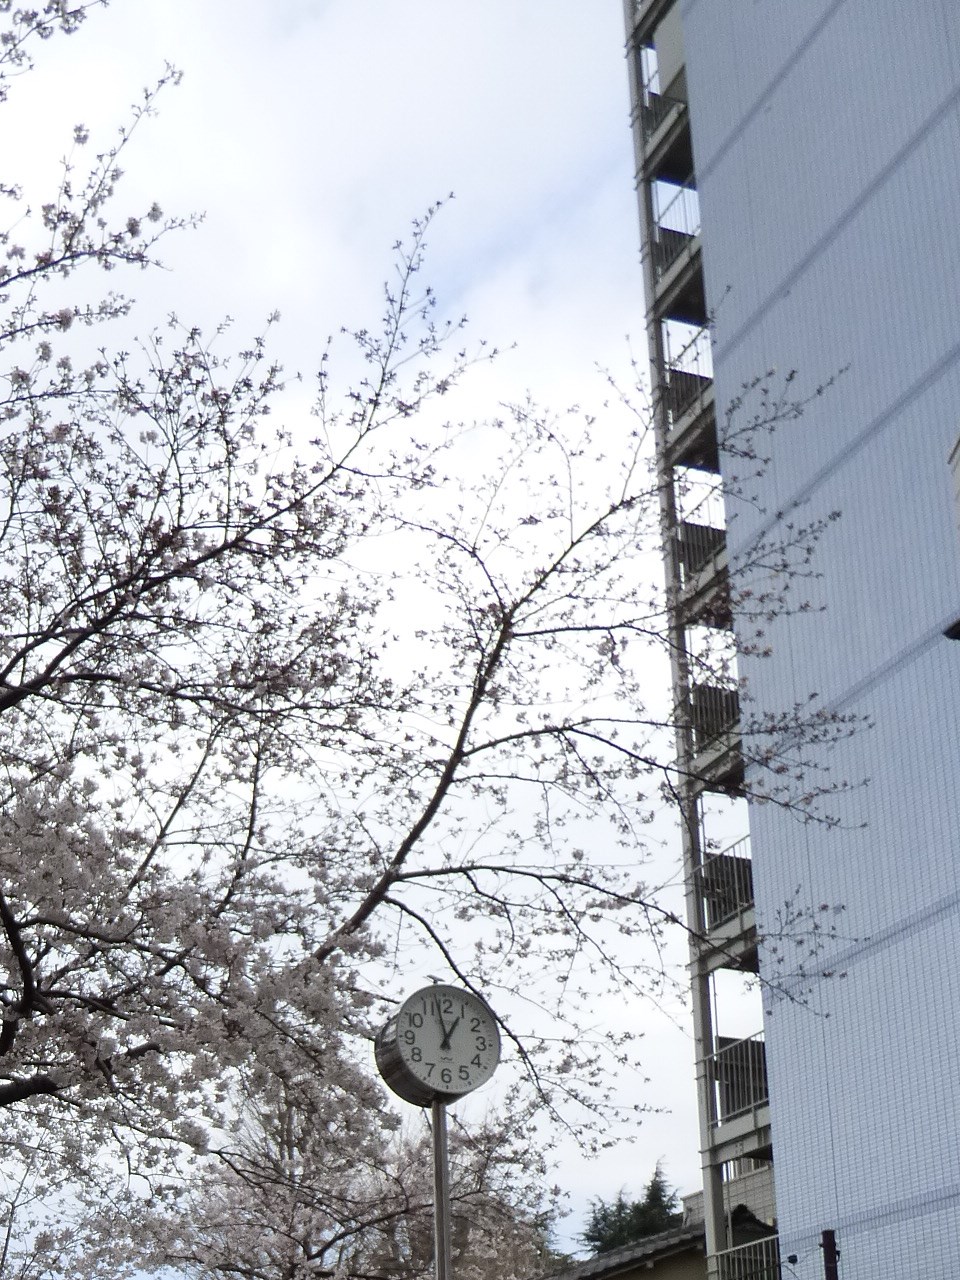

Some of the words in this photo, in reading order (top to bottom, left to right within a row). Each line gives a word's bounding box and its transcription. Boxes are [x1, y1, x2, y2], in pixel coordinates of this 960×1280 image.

[423, 1000, 435, 1016] 11
[438, 999, 453, 1014] 12
[407, 1013, 423, 1028] 10
[471, 1018, 481, 1033] 2
[404, 1030, 415, 1045] 9
[475, 1036, 486, 1051] 3
[411, 1048, 422, 1062] 8
[471, 1054, 481, 1068] 4
[426, 1063, 436, 1077] 7
[441, 1068, 452, 1083] 6
[459, 1066, 469, 1080] 5
